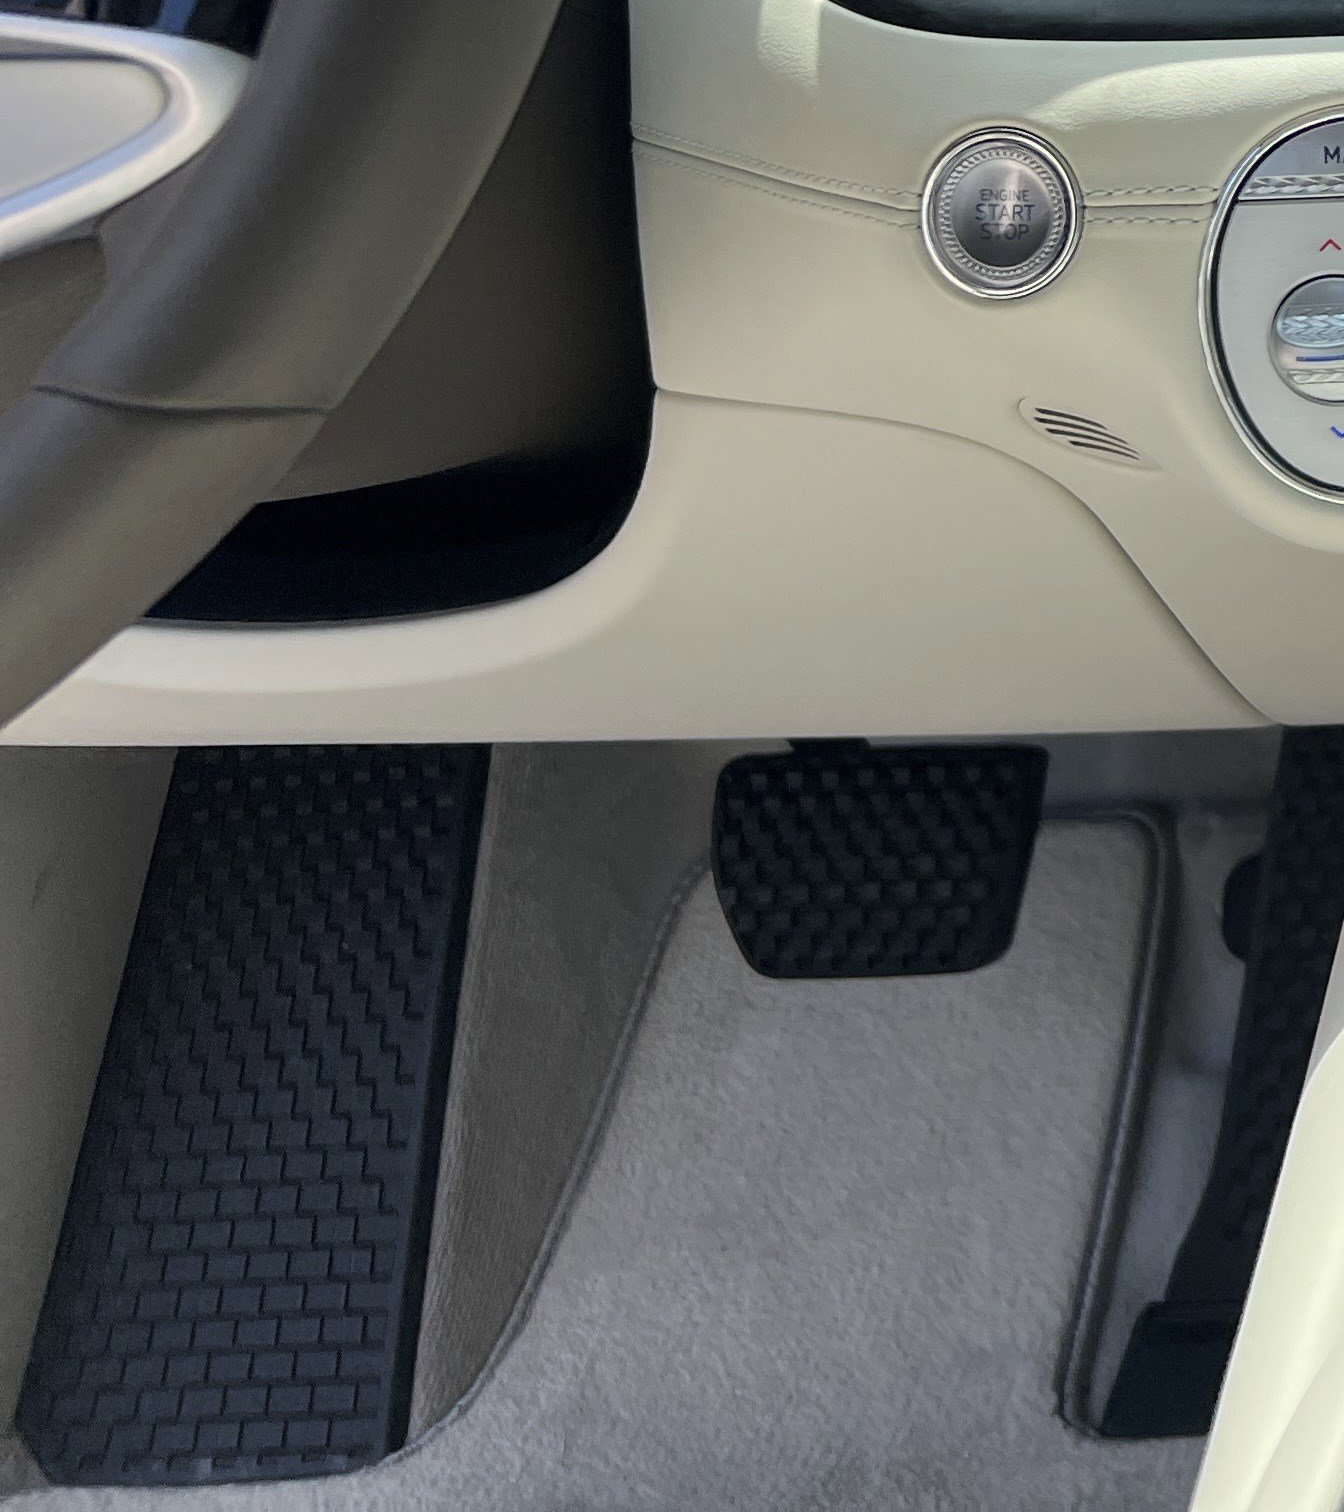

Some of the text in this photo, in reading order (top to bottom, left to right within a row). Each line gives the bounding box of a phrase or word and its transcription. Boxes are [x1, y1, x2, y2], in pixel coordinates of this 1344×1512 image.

[980, 189, 1030, 202] ENGINE
[975, 204, 1035, 221] START
[980, 223, 1030, 240] STOP
